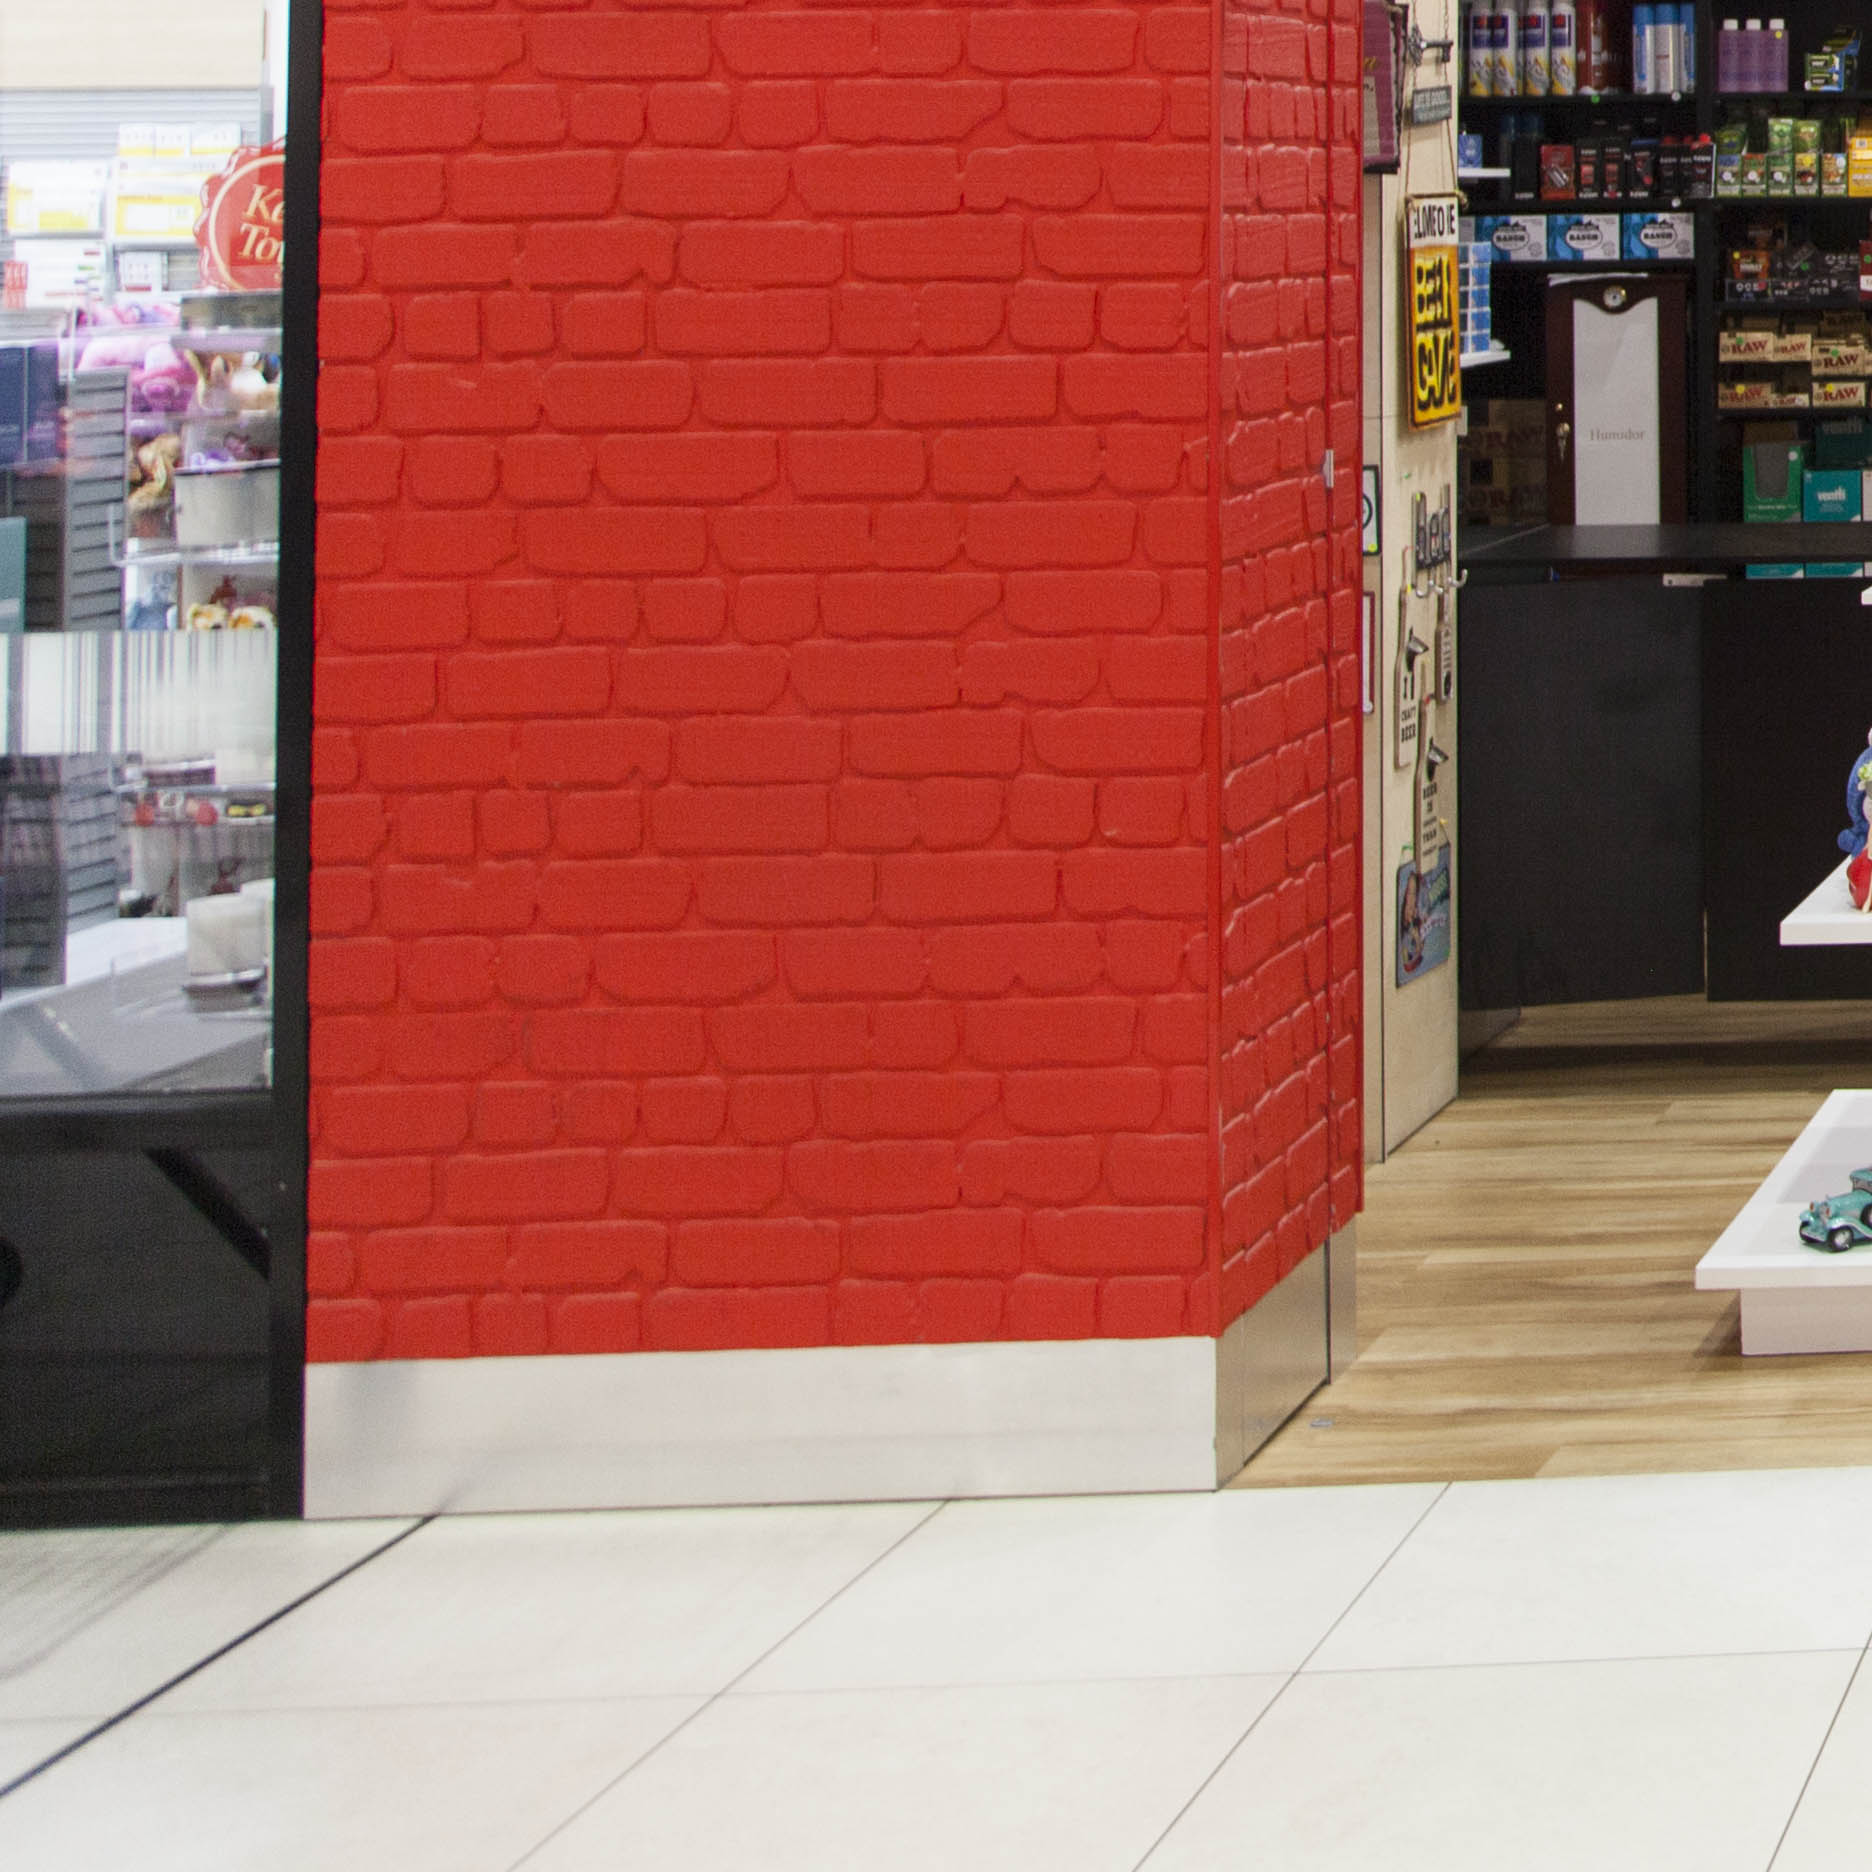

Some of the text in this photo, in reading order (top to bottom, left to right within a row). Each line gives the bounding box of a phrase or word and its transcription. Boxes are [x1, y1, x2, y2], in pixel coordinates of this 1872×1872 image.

[1731, 340, 1768, 354] RAW
[1823, 354, 1859, 368] RAW
[1823, 387, 1859, 401] RAW
[1590, 430, 1646, 441] Humidor
